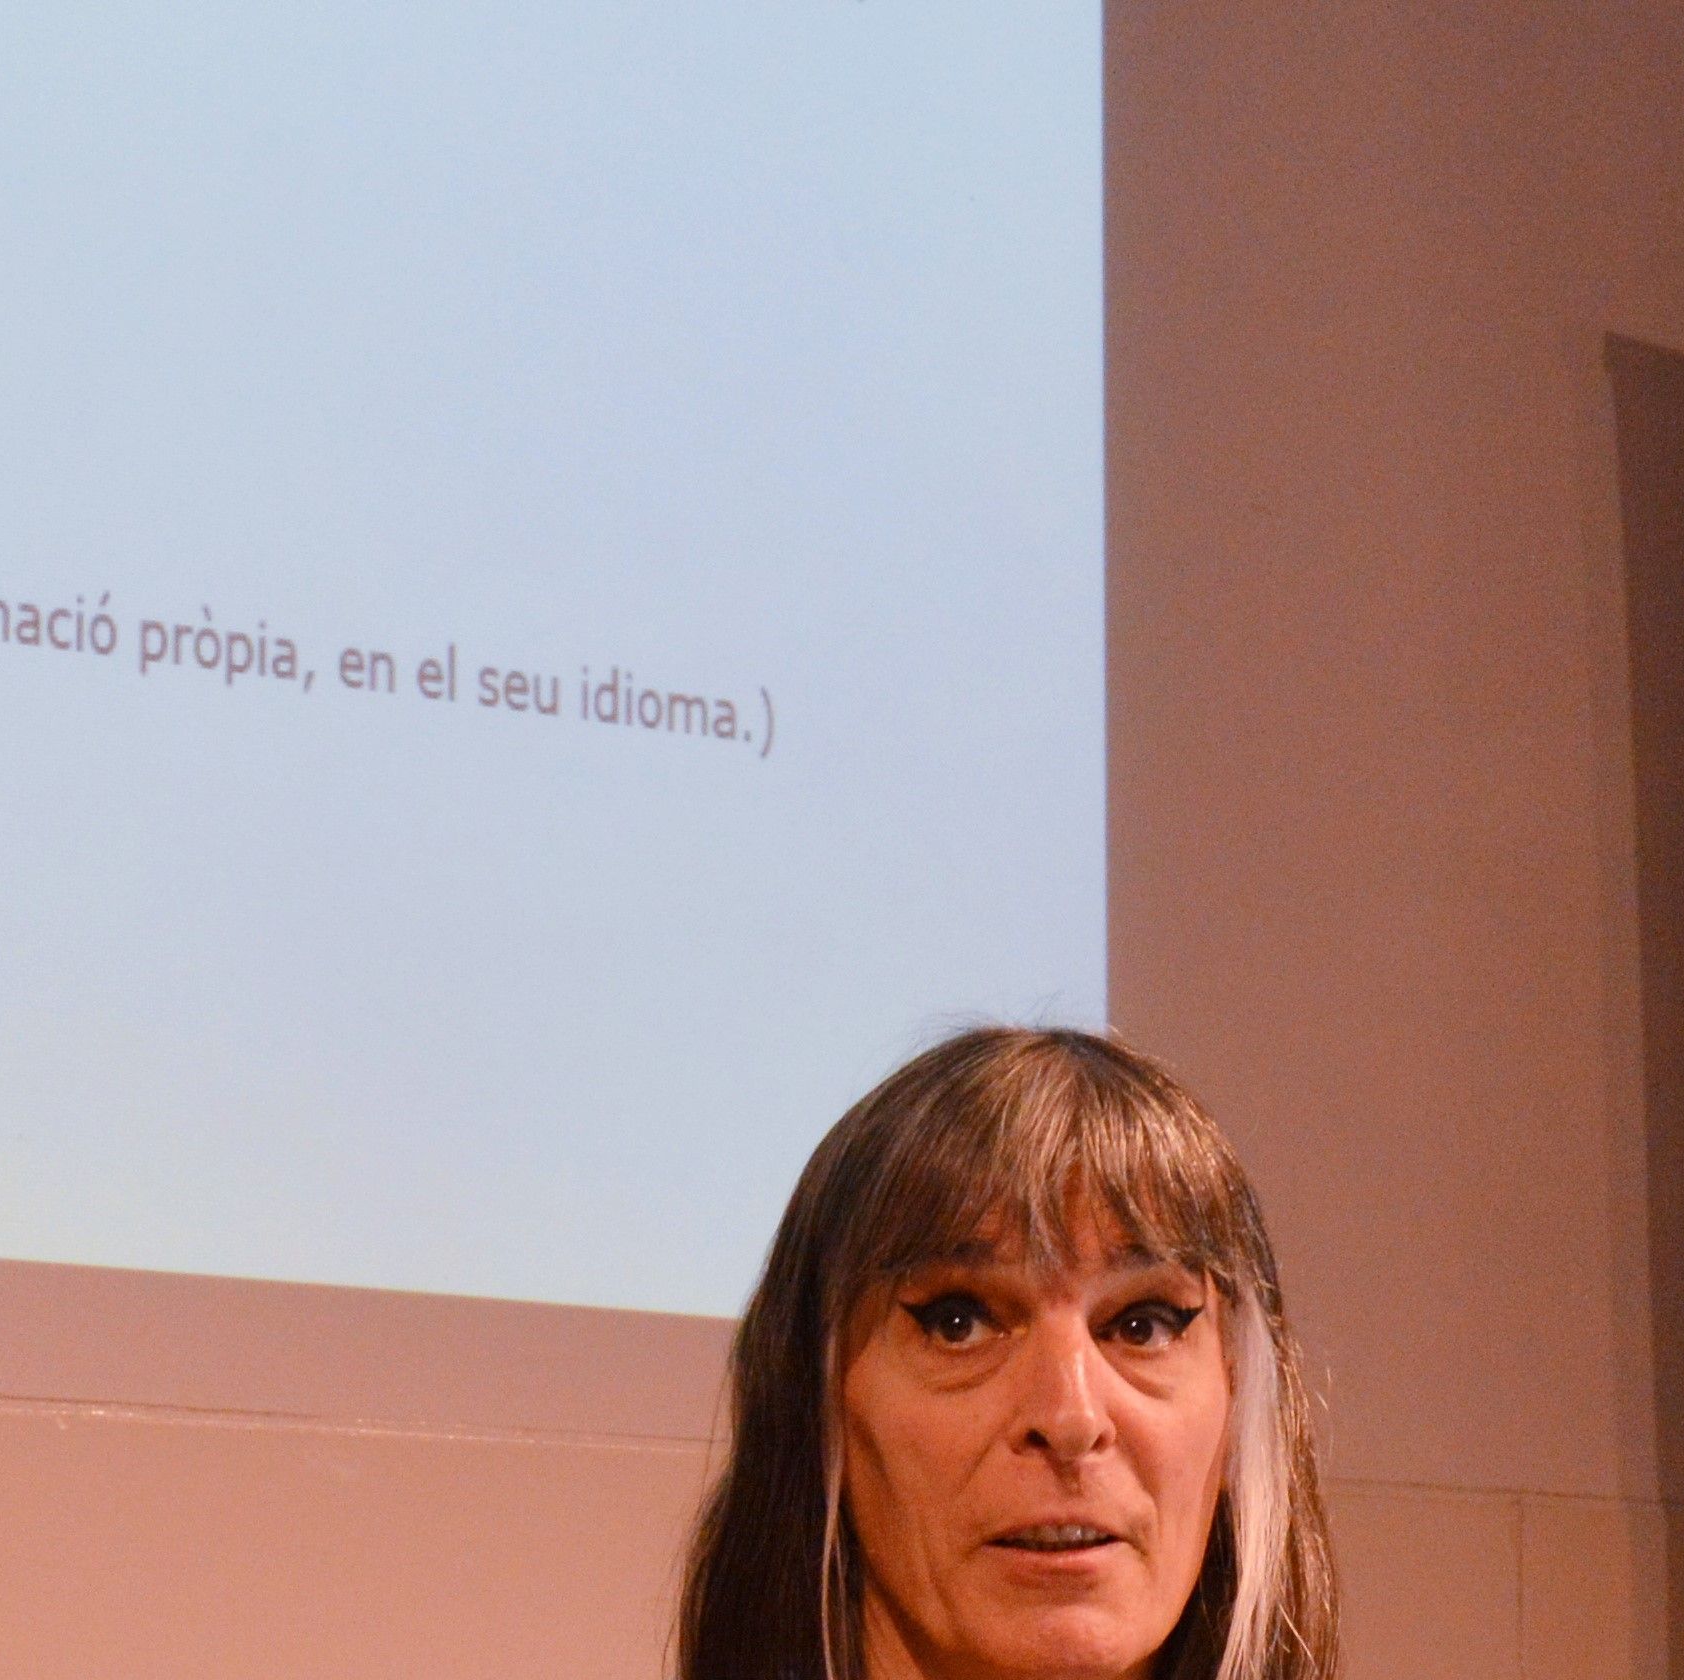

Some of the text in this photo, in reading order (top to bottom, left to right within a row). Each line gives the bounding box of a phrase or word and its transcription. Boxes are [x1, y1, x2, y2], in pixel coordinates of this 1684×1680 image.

[139, 606, 315, 691] pròpia,
[339, 648, 394, 692] en
[416, 645, 455, 700] el
[479, 667, 559, 715] seu
[581, 668, 774, 758] idioma.)
